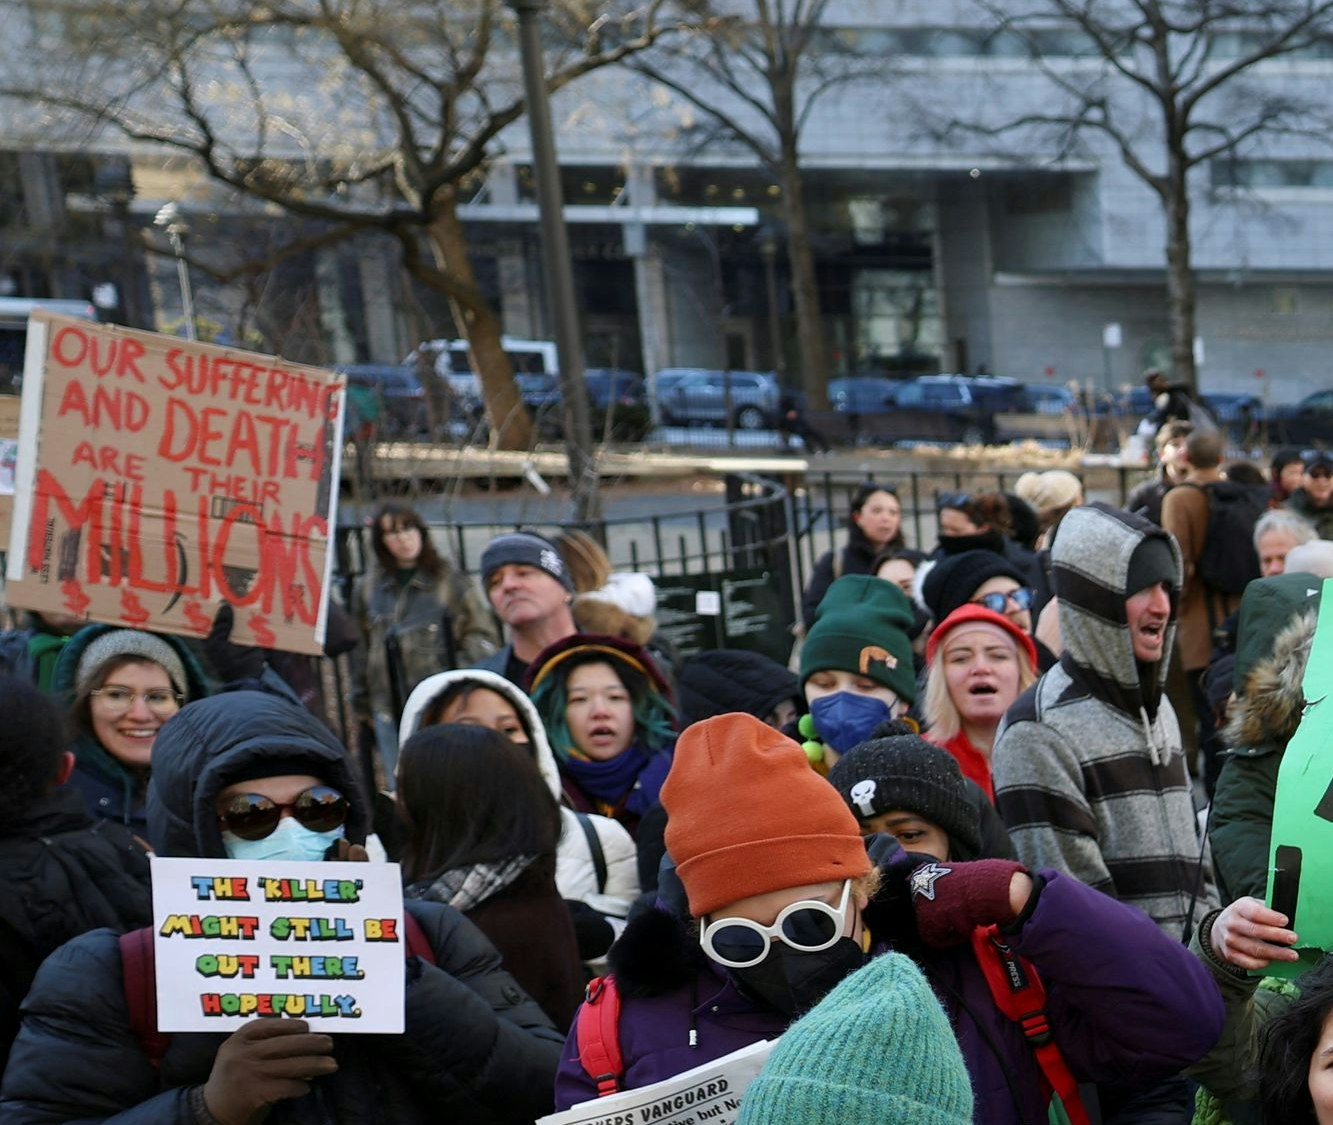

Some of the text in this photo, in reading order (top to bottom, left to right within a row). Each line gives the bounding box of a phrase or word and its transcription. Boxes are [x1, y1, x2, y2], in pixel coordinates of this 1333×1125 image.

[52, 327, 344, 421] OUR SUFFERING
[57, 379, 325, 482] AND DEATH
[71, 441, 282, 505] ARE THEIR
[28, 469, 328, 629] MILLIONS
[191, 876, 251, 901] THE
[159, 914, 399, 942] MIGHT STILL BE
[195, 954, 366, 980] OUT THERE.
[200, 993, 362, 1019] HOPEFULLY.
[641, 1077, 729, 1123] VANGUARD
[696, 1104, 723, 1121] but
